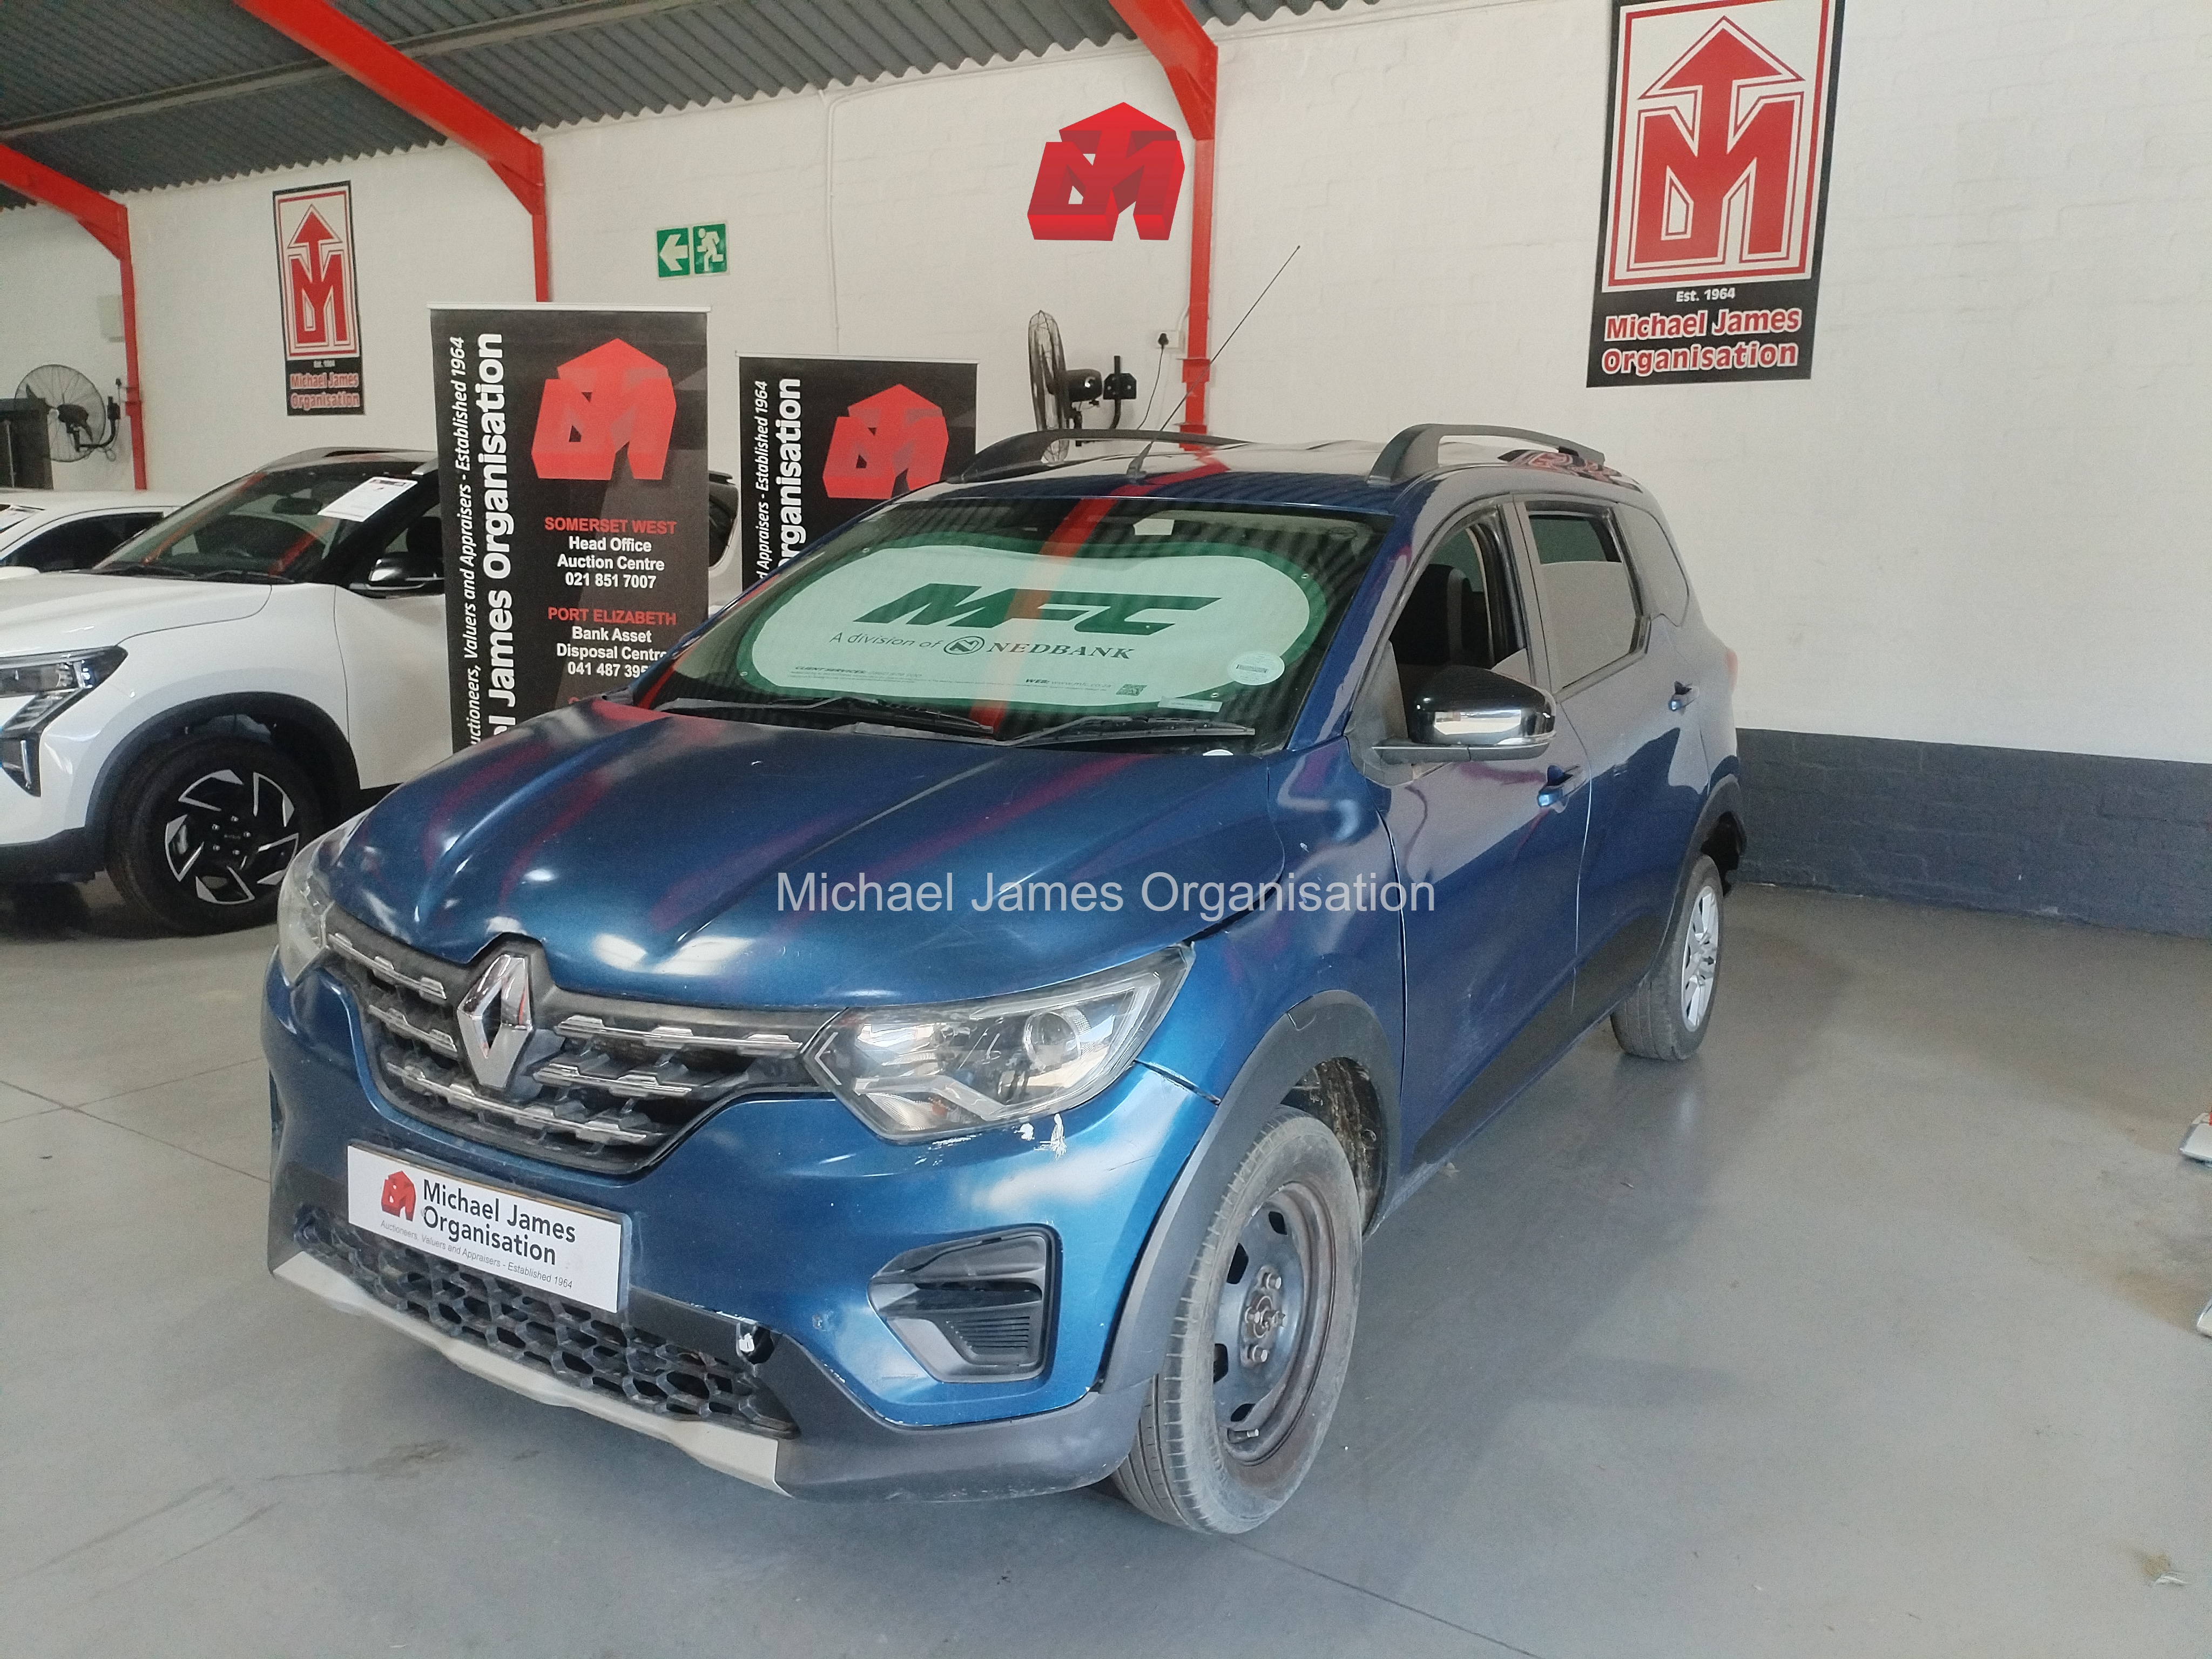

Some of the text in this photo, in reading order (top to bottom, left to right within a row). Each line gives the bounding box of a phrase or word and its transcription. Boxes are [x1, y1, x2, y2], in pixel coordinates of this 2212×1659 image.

[1676, 287, 1736, 302] Est. 1964
[1604, 307, 1802, 342] Michael James
[450, 336, 466, 376] 1964
[1602, 340, 1799, 377] Organisation
[290, 372, 359, 389] Michael James
[754, 380, 768, 414] 1964
[291, 391, 360, 411] Organisation
[450, 380, 470, 470] Established
[475, 333, 515, 579] Organisation
[754, 416, 770, 492] Established
[457, 484, 477, 568] Appraisers
[545, 517, 677, 534] SOMERSET WEST
[756, 501, 773, 570] Appraisers
[569, 536, 652, 552] Head Office
[557, 554, 665, 571] Auction Centre
[459, 568, 476, 600] and
[565, 572, 657, 589] 021 851 7007
[548, 606, 677, 625] PORT ELIZABETH
[853, 583, 1223, 636] MFC
[462, 602, 478, 659] Valuers
[572, 626, 652, 643] Bank Asset
[829, 632, 1135, 659] A division of NEDBANK
[488, 589, 516, 708] James
[557, 643, 618, 659] Disposal
[568, 662, 591, 675] 041
[596, 663, 621, 677] 487
[466, 664, 482, 745] uctioneers,
[423, 1179, 576, 1243] Michael James
[423, 1205, 556, 1266] Organisation
[380, 1220, 420, 1242] Auctioneers,
[421, 1235, 446, 1250] Valuers
[448, 1243, 461, 1255] and
[462, 1248, 501, 1267] Appraisers
[508, 1262, 552, 1283] Established
[554, 1276, 574, 1289] 1964
